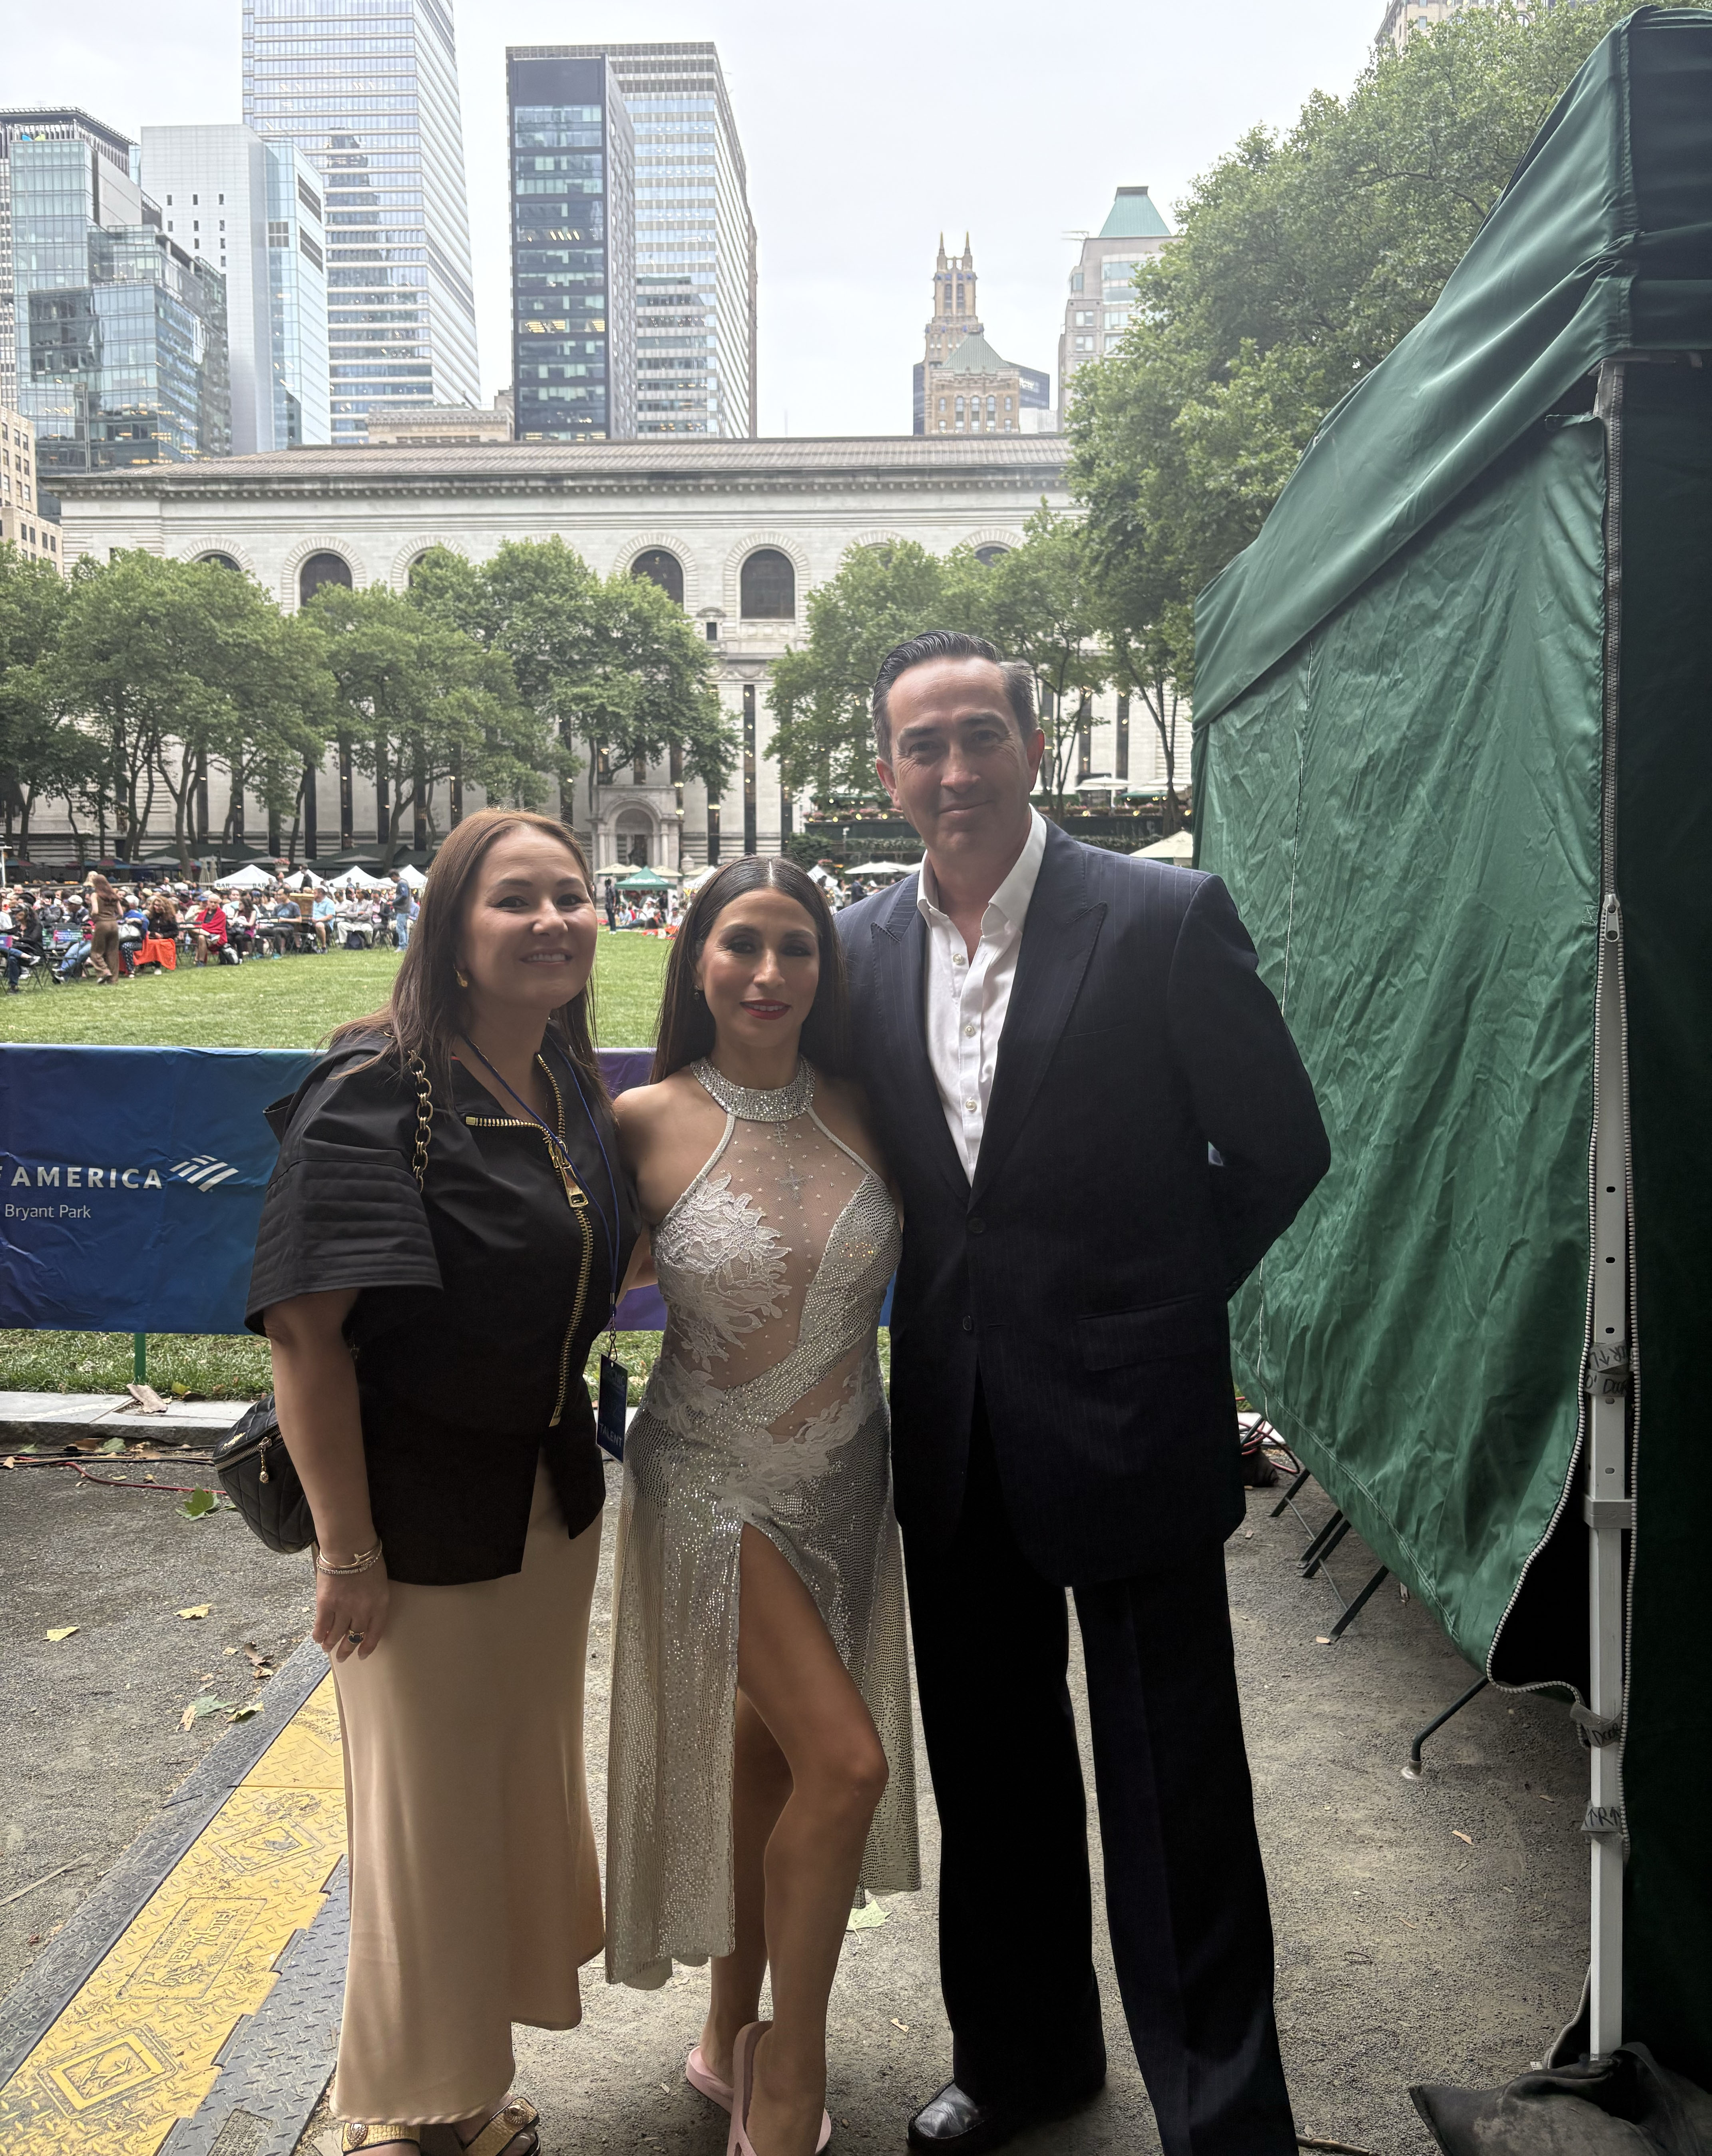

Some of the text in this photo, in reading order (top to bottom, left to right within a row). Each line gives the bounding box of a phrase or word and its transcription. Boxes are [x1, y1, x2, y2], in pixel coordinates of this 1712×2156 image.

[11, 1166, 162, 1189] AMERICA
[5, 1204, 91, 1221] Bryant Park
[599, 1423, 622, 1447] TALENT
[199, 1906, 242, 1945] YELLOW
[169, 1926, 208, 1963] JACKET
[209, 1941, 231, 1964] WORLD
